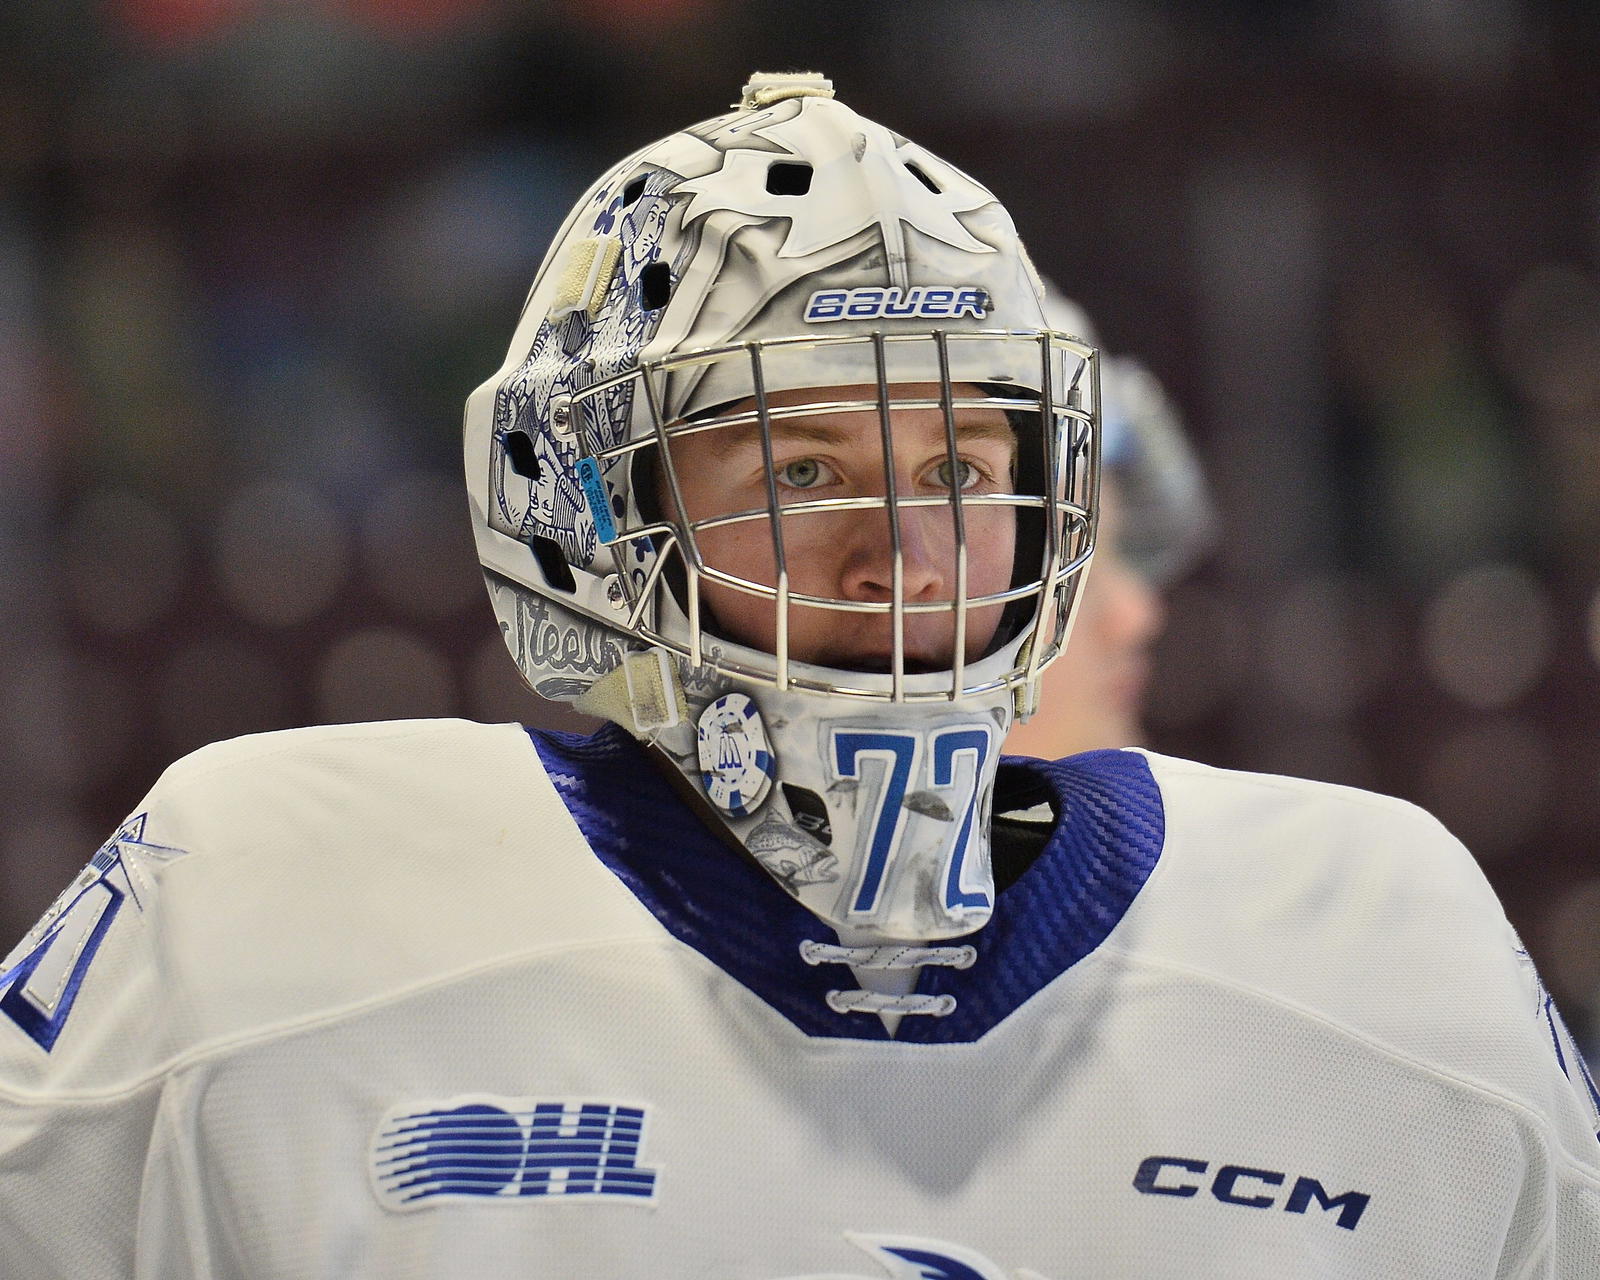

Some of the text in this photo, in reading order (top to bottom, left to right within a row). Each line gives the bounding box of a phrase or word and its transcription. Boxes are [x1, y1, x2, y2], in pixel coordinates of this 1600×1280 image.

[806, 287, 989, 321] BAUER
[834, 729, 991, 912] 72
[376, 1103, 656, 1204] OHL
[1132, 1155, 1371, 1231] CCM
